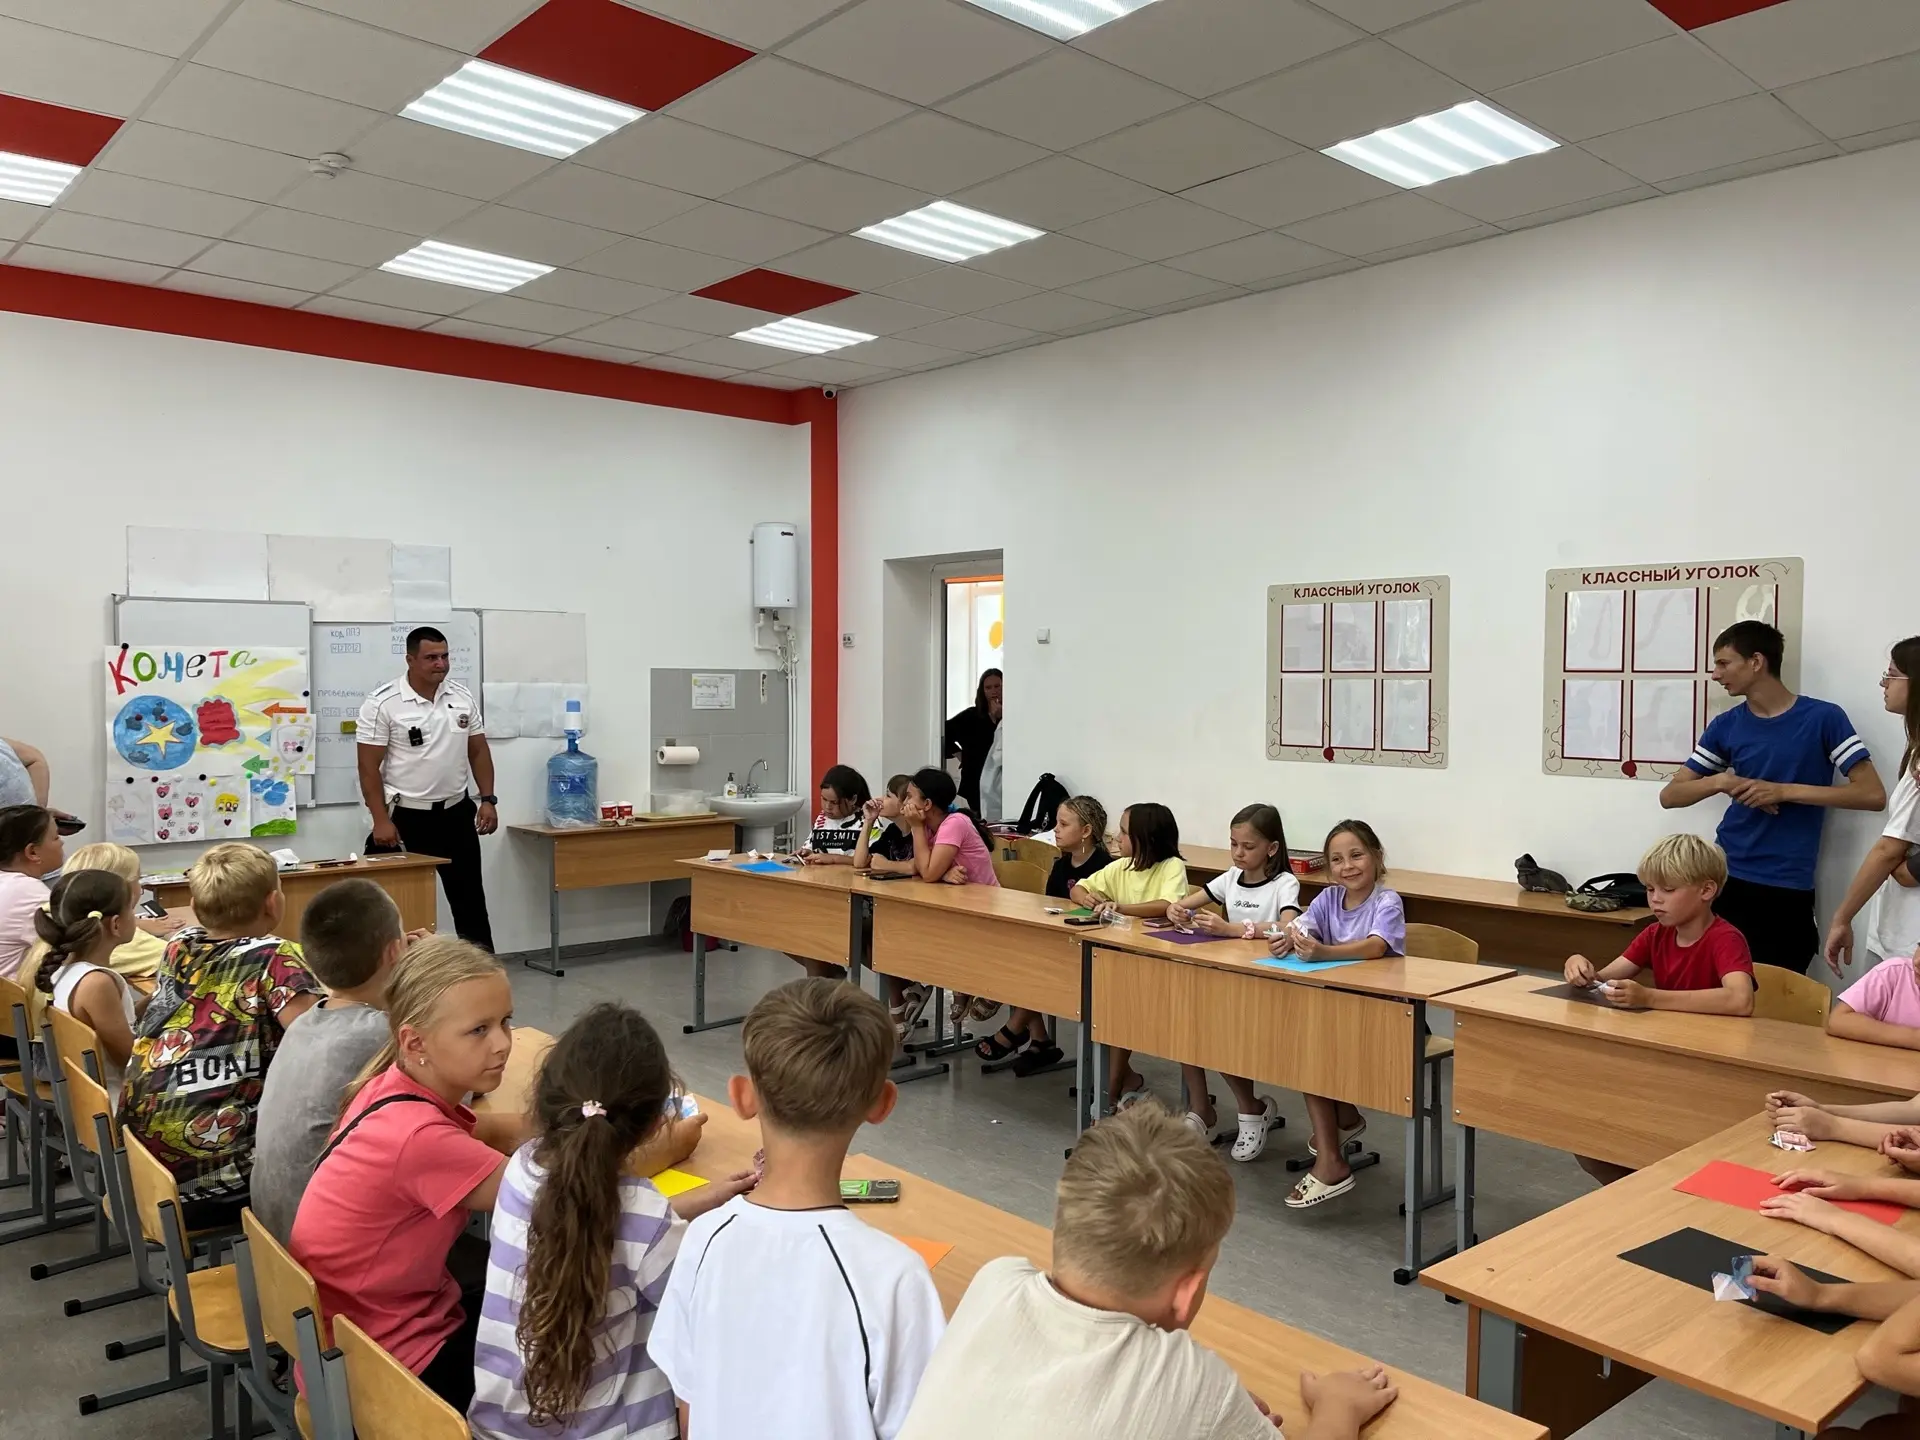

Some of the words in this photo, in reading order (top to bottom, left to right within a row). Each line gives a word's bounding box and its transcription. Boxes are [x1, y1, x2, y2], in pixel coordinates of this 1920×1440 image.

[1582, 566, 1681, 585] КЛАССНЫЙ
[1685, 564, 1761, 581] УГОЛОК
[1294, 582, 1364, 598] КЛАССНЫЙ
[1367, 581, 1421, 595] УГОЛОК
[331, 631, 344, 639] КОД
[176, 1050, 261, 1086] GOAL
